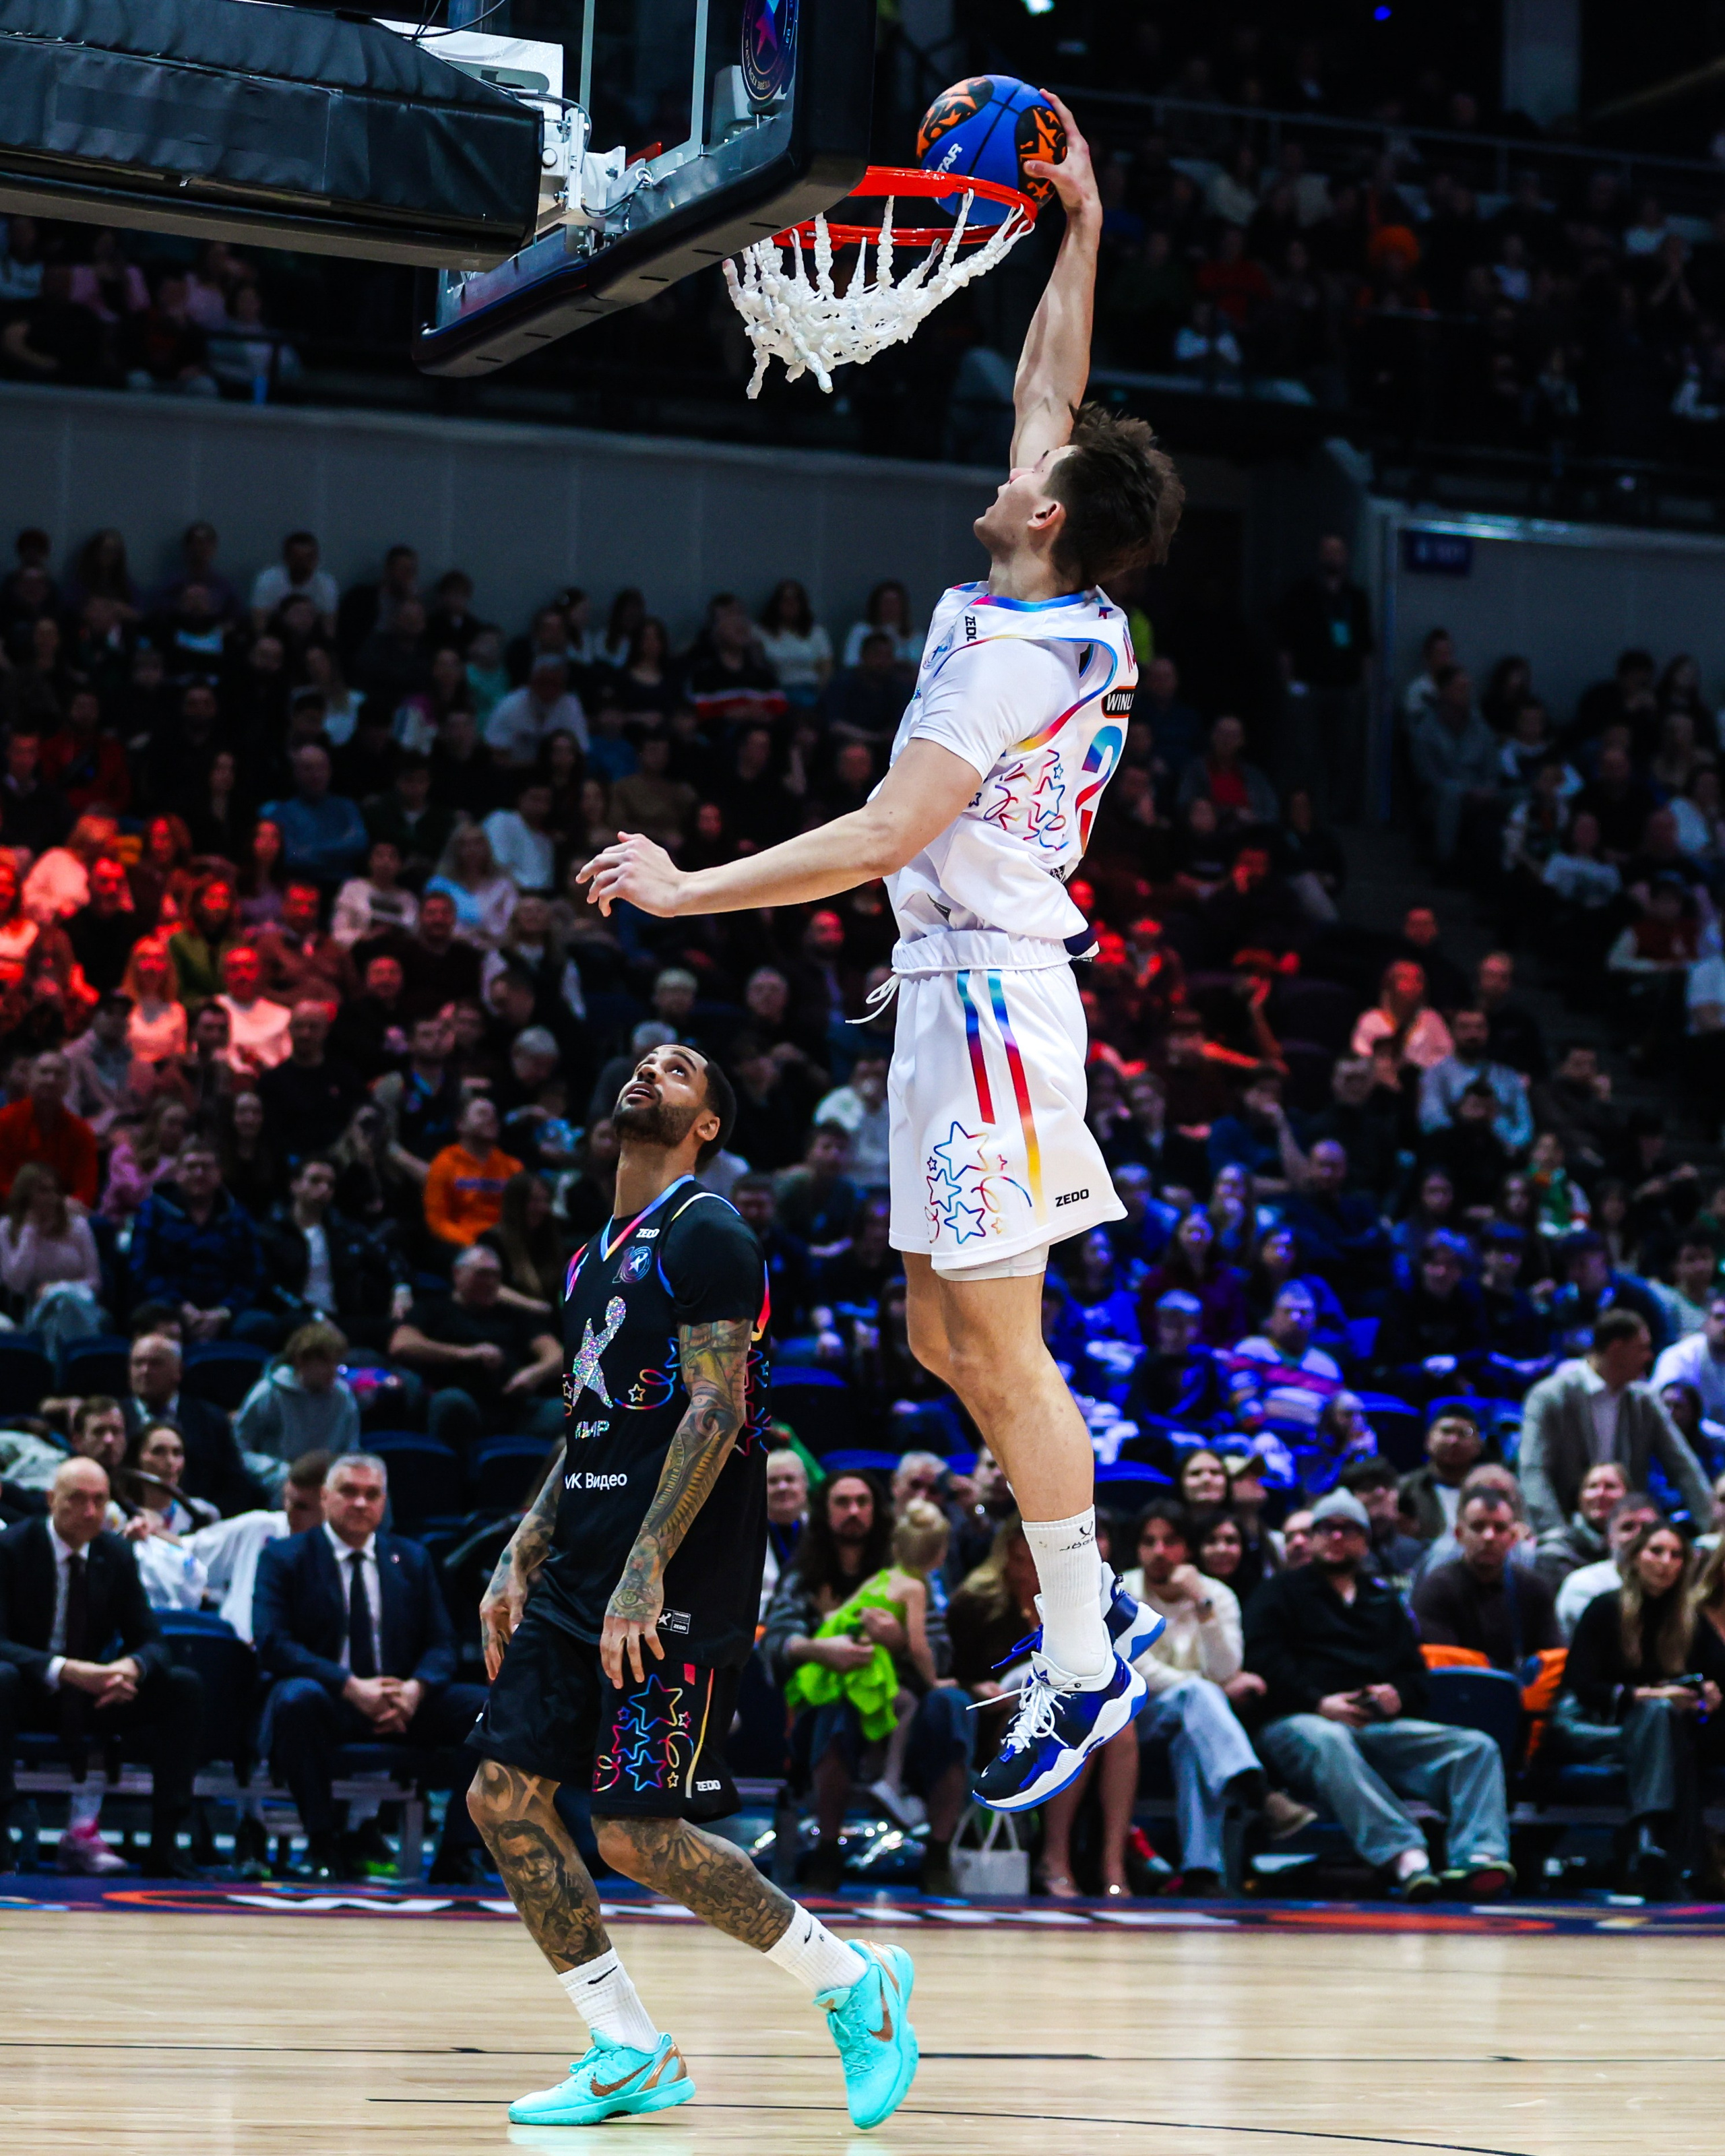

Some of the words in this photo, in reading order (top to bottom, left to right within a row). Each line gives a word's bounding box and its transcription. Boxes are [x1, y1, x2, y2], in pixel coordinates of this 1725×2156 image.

[1055, 1188, 1090, 1207] ZEDO
[636, 1228, 660, 1238] ZEDO
[565, 1472, 582, 1490] VK
[585, 1472, 627, 1490] Видео
